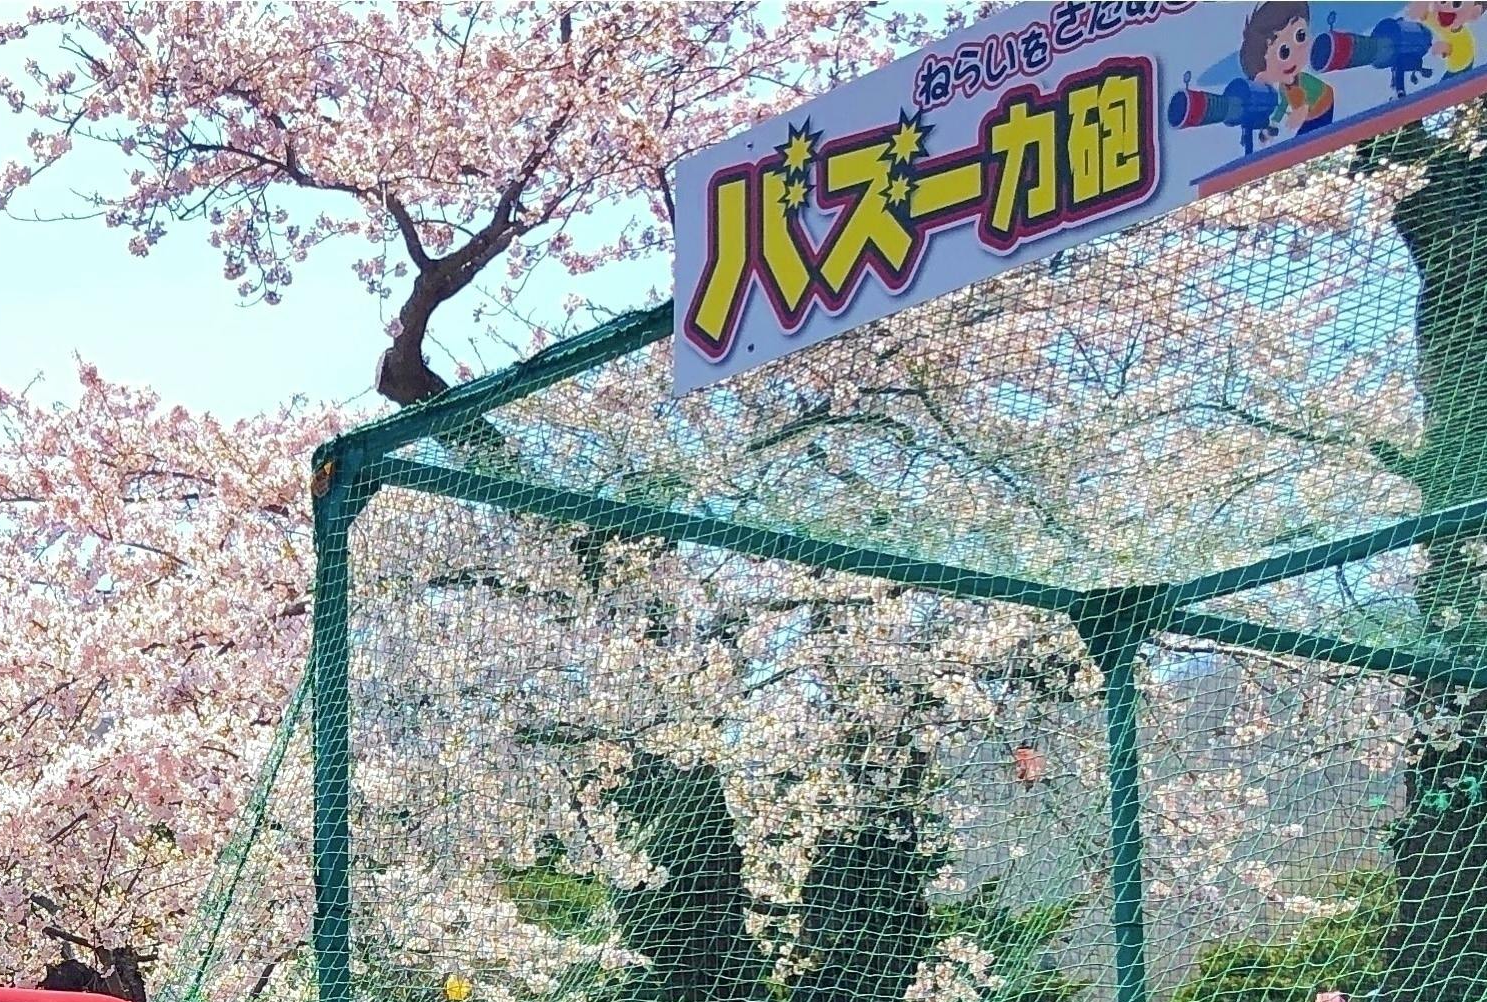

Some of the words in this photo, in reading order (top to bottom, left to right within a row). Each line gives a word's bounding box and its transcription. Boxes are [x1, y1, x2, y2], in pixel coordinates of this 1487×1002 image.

[690, 74, 1146, 347] バズーカ砲
